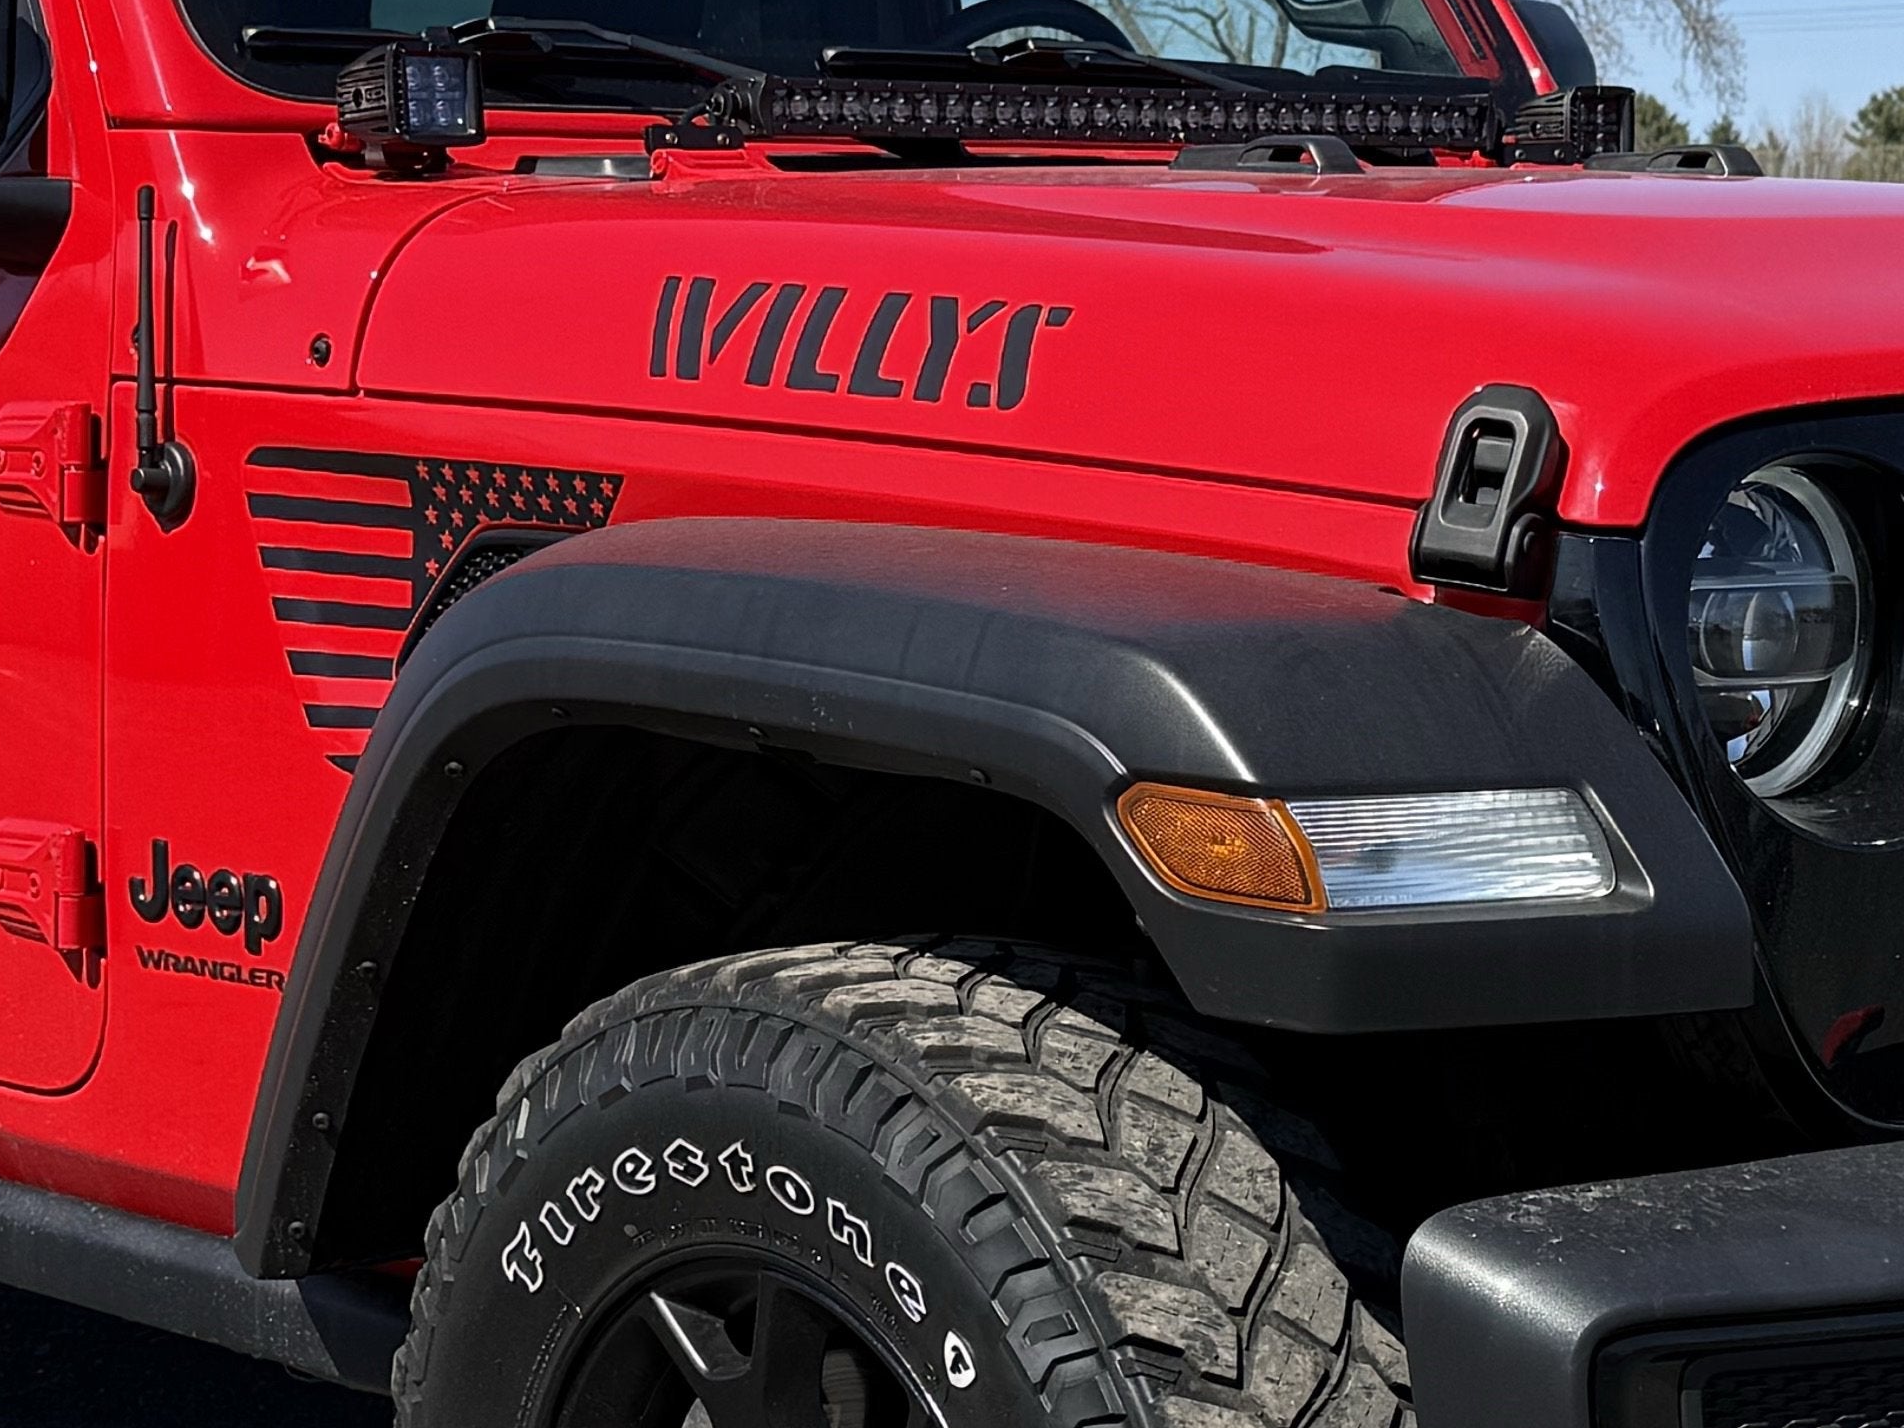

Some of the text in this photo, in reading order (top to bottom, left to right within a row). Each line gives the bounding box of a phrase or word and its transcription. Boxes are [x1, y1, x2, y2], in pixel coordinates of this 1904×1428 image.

[649, 275, 1075, 411] WILLYS
[128, 838, 284, 956] Jeep
[134, 945, 286, 993] WRANGLER
[500, 1137, 928, 1323] Firestone
